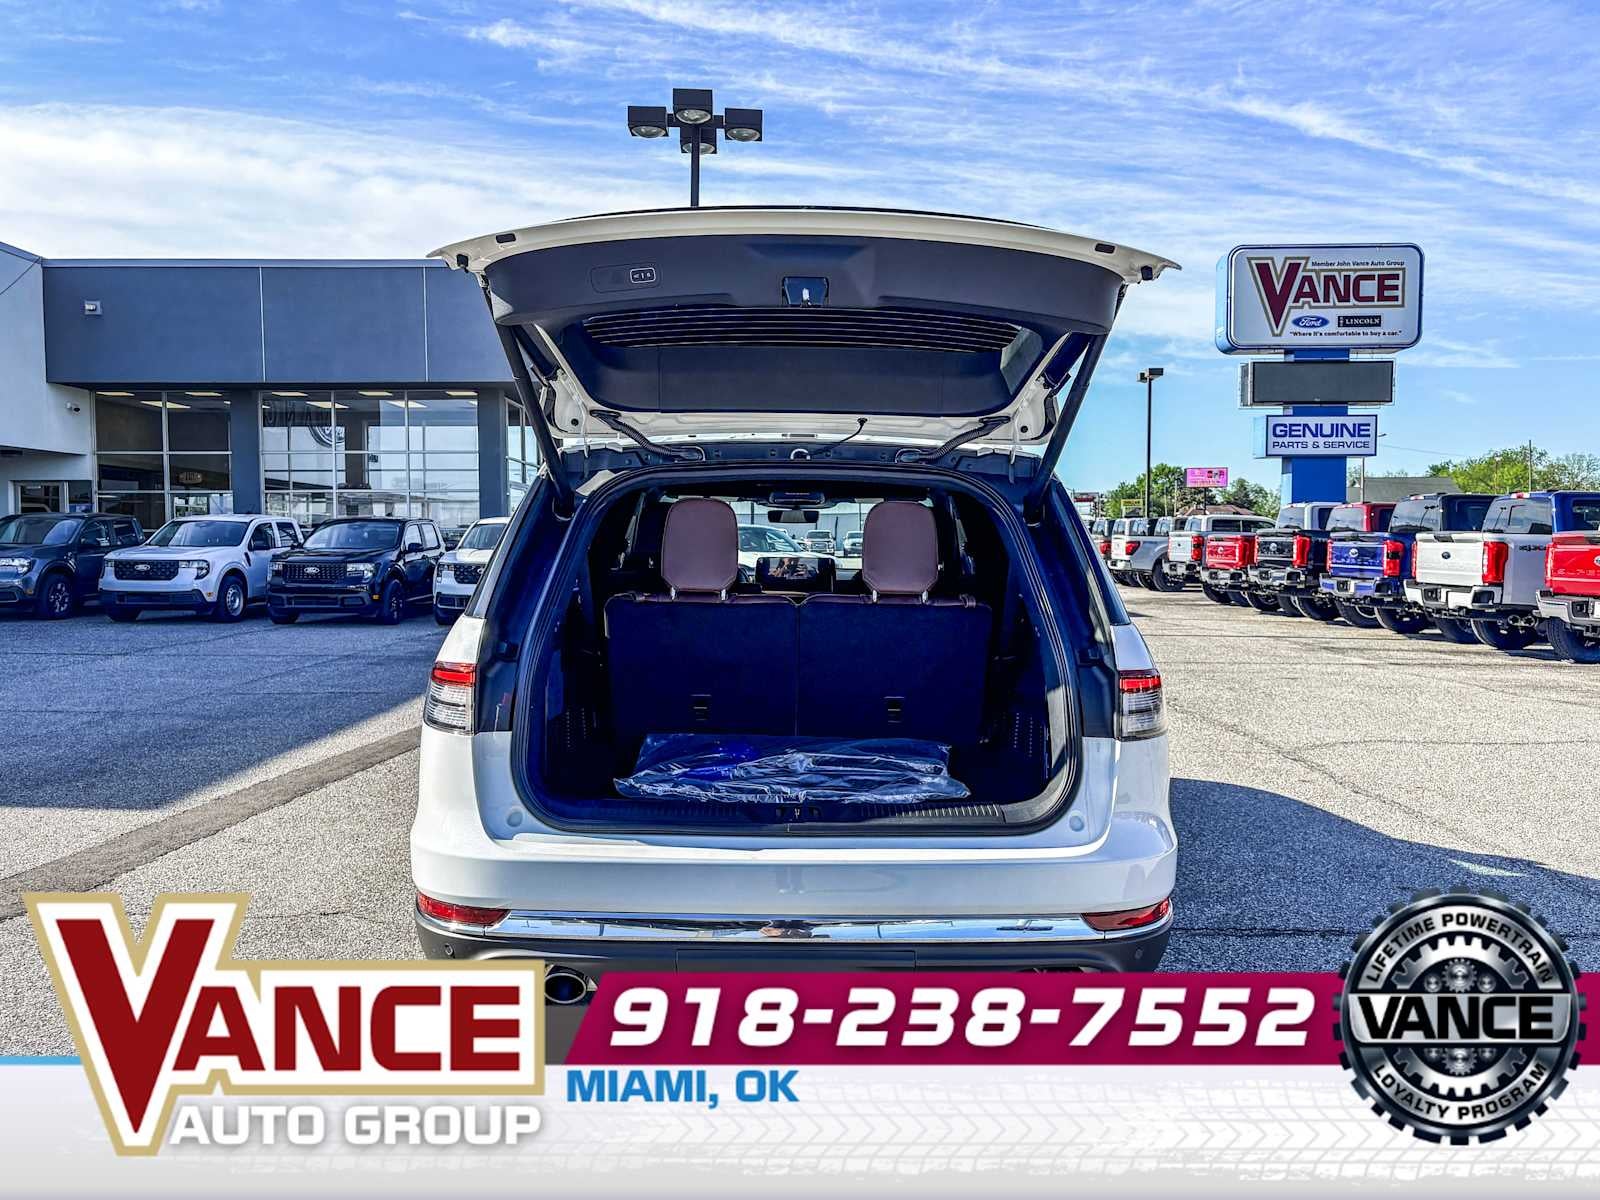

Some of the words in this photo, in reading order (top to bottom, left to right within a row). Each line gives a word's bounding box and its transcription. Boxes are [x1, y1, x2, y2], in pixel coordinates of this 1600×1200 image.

[1254, 262, 1400, 330] VANCE
[1299, 317, 1322, 328] Ford
[1345, 317, 1380, 325] LINCOLN
[1272, 423, 1371, 438] GENUINE
[1272, 441, 1309, 449] PARTS
[1312, 441, 1320, 449] &
[1323, 441, 1370, 449] SERVICE
